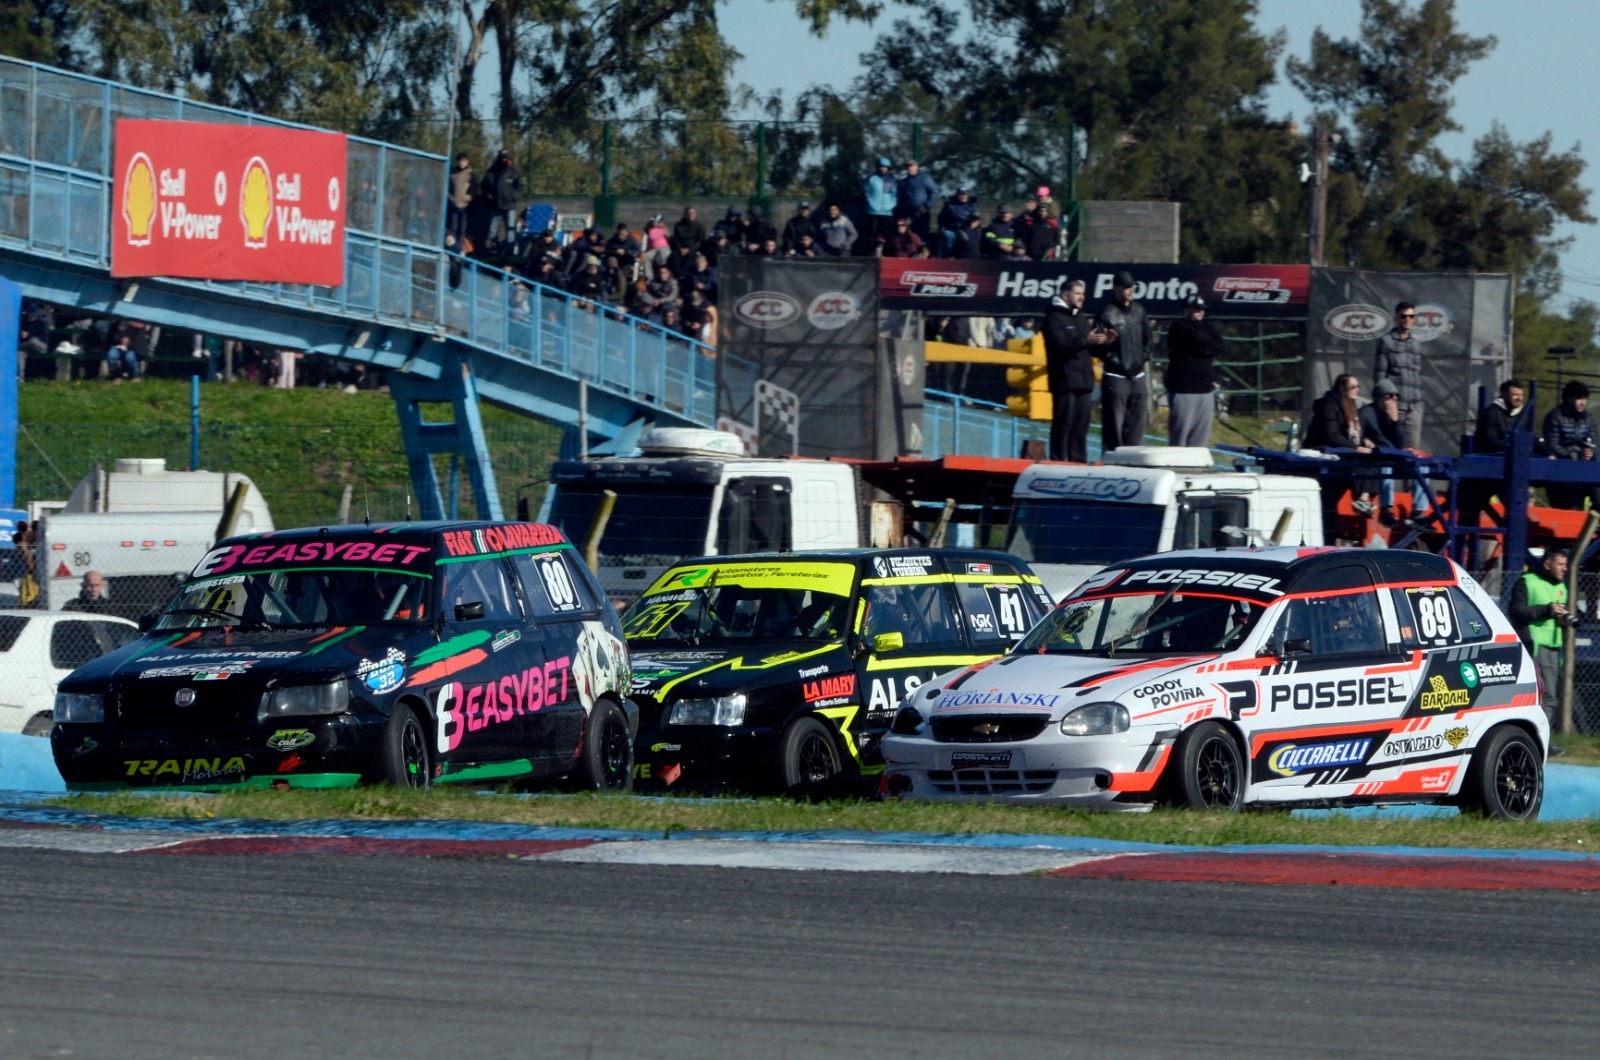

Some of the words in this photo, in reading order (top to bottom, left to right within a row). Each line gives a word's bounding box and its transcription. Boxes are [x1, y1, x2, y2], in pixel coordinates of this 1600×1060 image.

[160, 168, 186, 197] Shell
[276, 174, 301, 202] Shell
[160, 202, 223, 240] V-Power
[276, 206, 336, 246] V-Power
[904, 273, 955, 283] Turismo
[920, 285, 958, 295] Pista
[996, 271, 1085, 298] Hast
[1093, 273, 1198, 301] Ponto
[442, 530, 477, 556] FIAT
[486, 523, 566, 552] OLAVARRIA
[73, 551, 92, 567] 80
[241, 542, 431, 565] EASYBET
[541, 560, 574, 605] 80
[1121, 569, 1286, 597] POSSIEL
[970, 614, 993, 628] NGK
[1000, 593, 1025, 631] 41
[1418, 596, 1452, 638] 89
[379, 671, 397, 689] 32
[797, 664, 829, 679] Transporte
[1475, 661, 1513, 677] Binder
[466, 656, 571, 732] EASYBET
[803, 680, 821, 700] LA
[821, 673, 856, 696] MARY
[1132, 678, 1184, 699] GODOY
[1151, 686, 1206, 709] POVIÑA
[1270, 677, 1407, 713] POSSIEL
[1421, 689, 1470, 710] BARDAHL
[1276, 737, 1374, 771] CICCARELLI
[1383, 734, 1444, 756] OSVALDO
[124, 757, 246, 776] TRAINA
